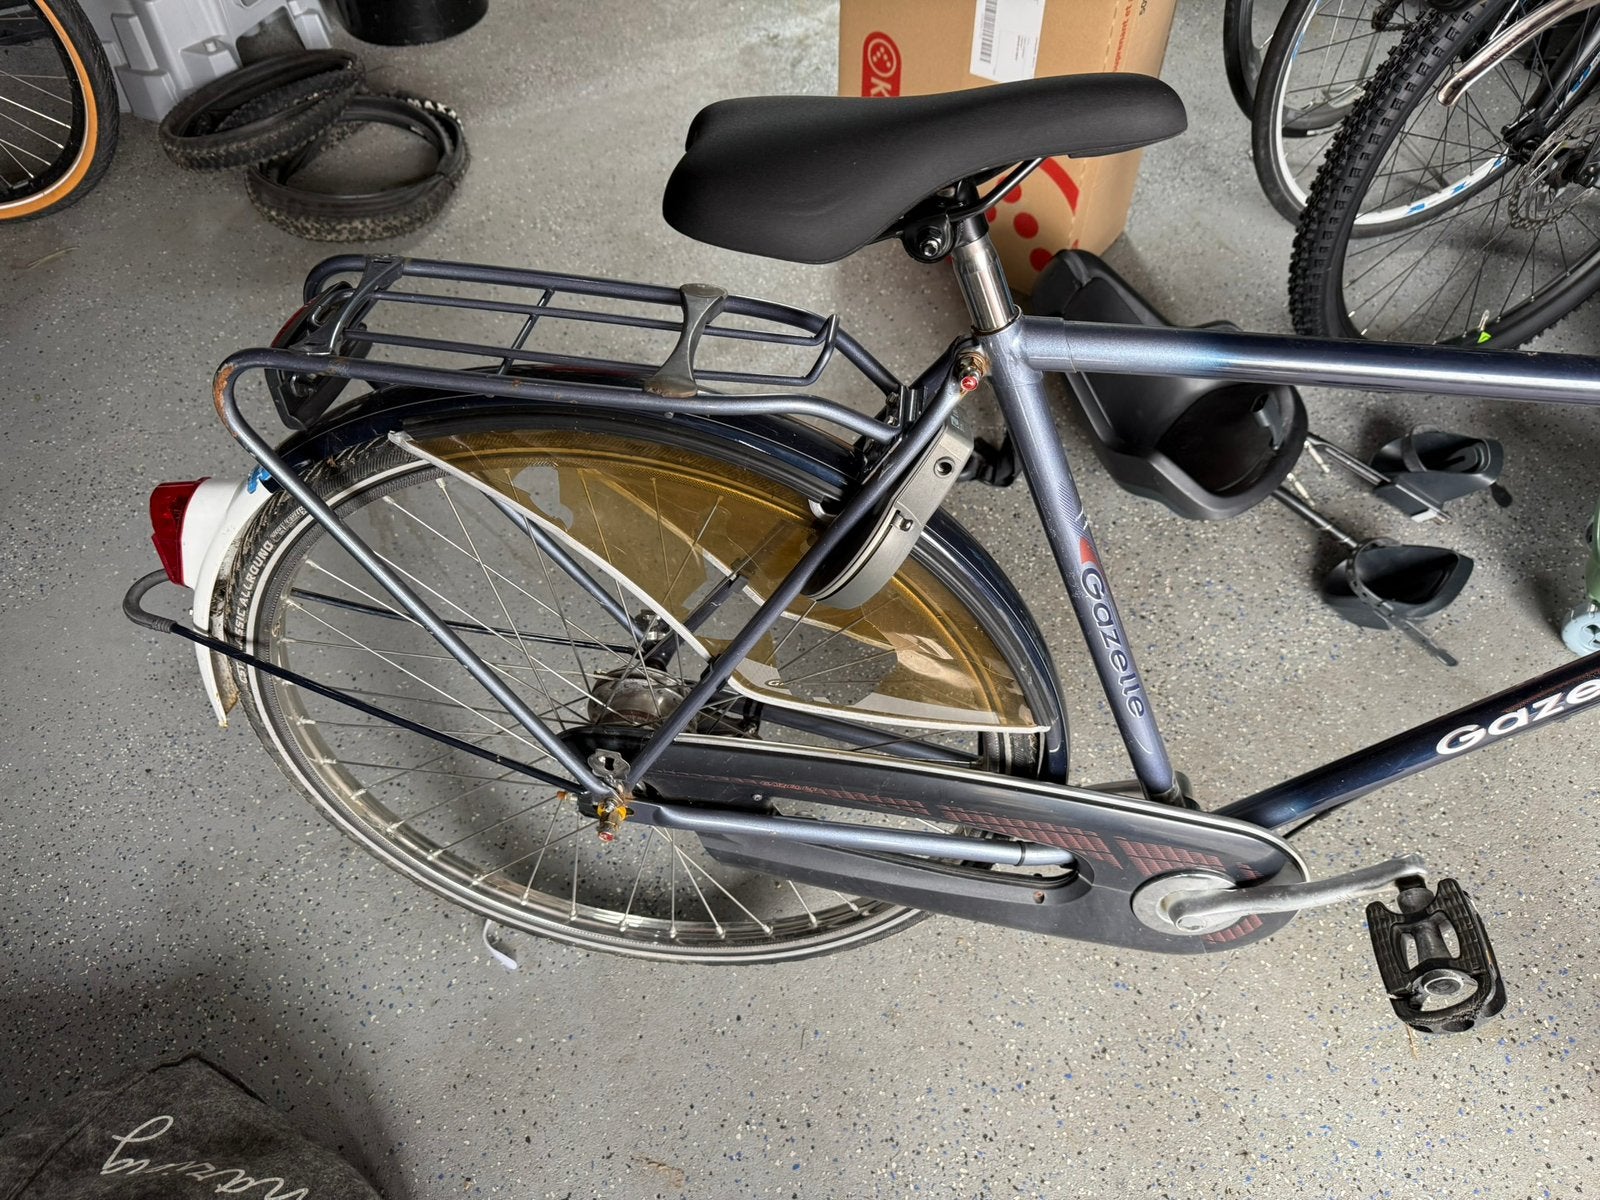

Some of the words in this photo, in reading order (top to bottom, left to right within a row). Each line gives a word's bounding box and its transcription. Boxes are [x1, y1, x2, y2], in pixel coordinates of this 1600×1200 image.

[238, 540, 275, 607] ALLROUND
[234, 606, 246, 651] ASSIC
[1081, 567, 1145, 718] Gazelle
[1436, 679, 1600, 755] Gaze
